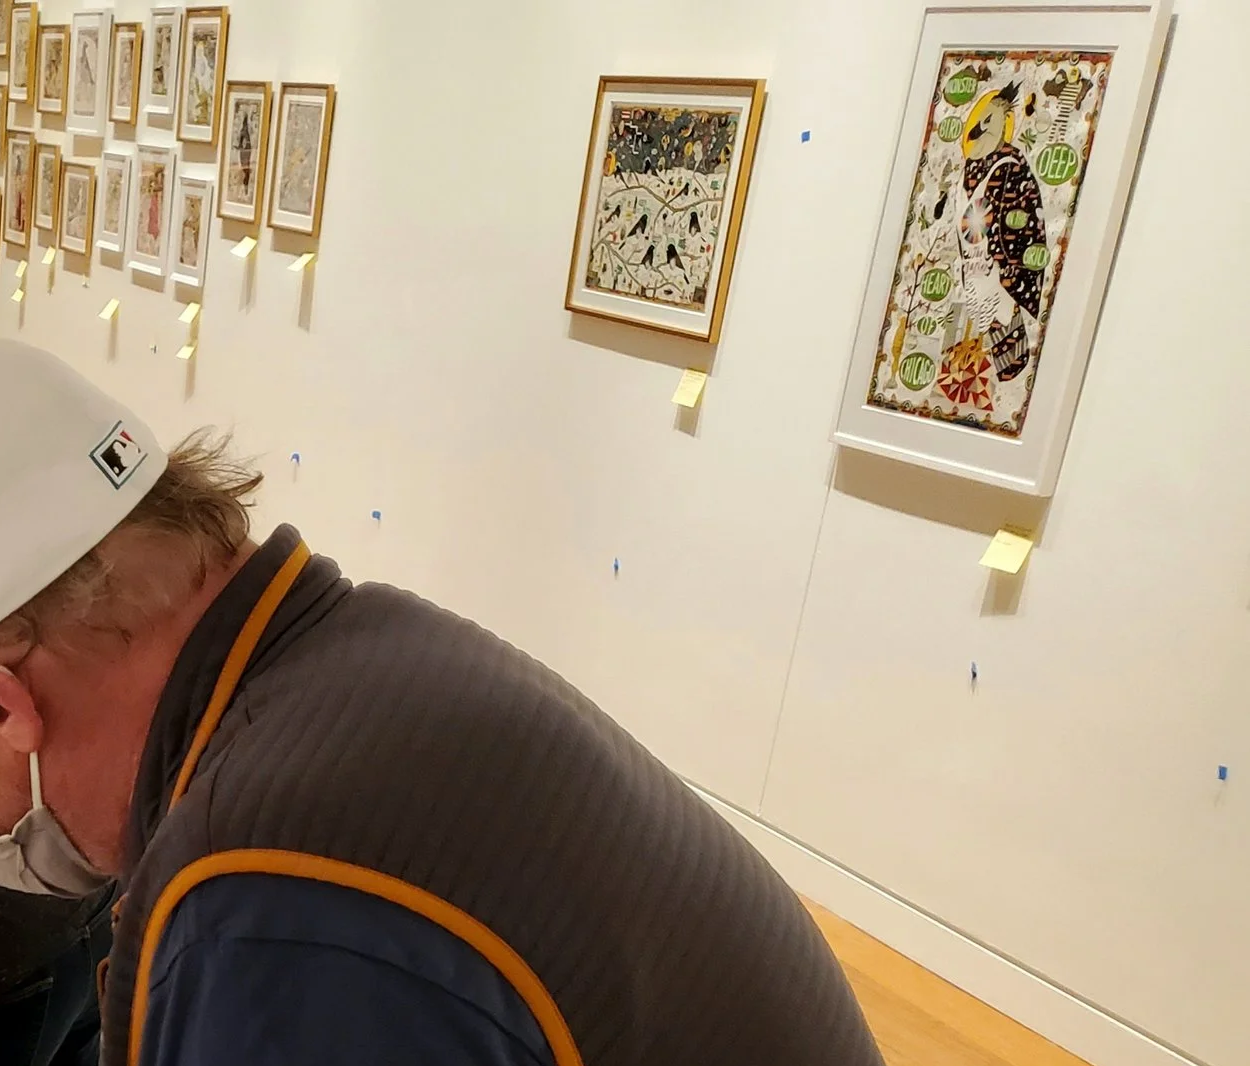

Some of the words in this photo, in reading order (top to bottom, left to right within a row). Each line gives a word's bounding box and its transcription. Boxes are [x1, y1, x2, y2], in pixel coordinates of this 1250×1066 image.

[939, 118, 962, 140] BIRD
[1038, 145, 1077, 180] DEEP
[921, 272, 949, 295] HEART
[920, 316, 935, 335] OF
[900, 356, 936, 386] CHICAGO
